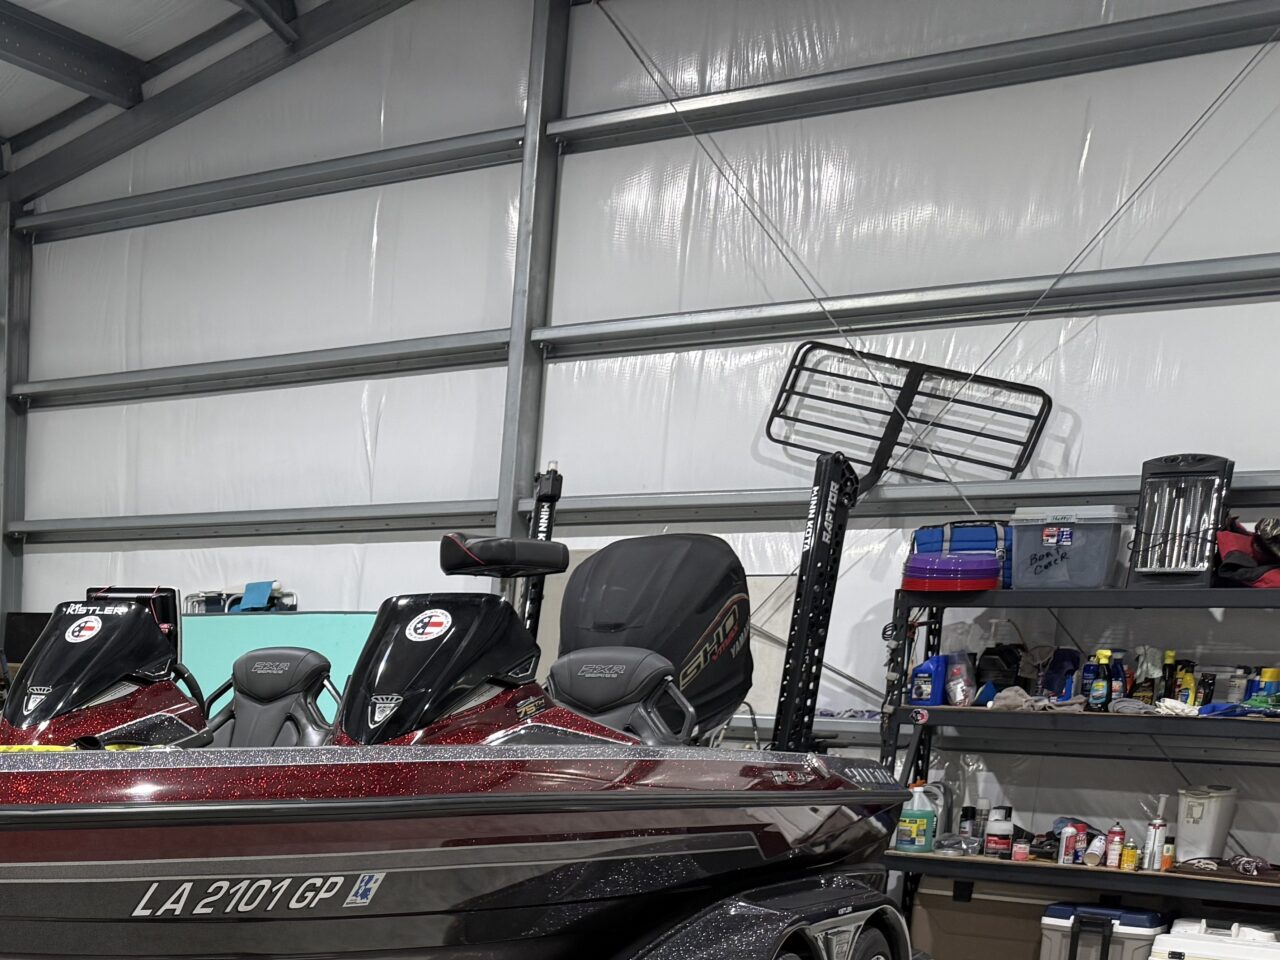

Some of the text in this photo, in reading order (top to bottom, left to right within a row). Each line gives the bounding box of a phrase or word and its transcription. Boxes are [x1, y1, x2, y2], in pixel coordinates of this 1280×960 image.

[538, 502, 550, 532] MINN
[802, 486, 819, 552] MINN KOTA
[822, 481, 839, 544] RAPTOR
[65, 606, 124, 616] KISTLER
[131, 881, 193, 917] LA
[192, 878, 293, 915] 2101
[289, 876, 345, 909] GP
